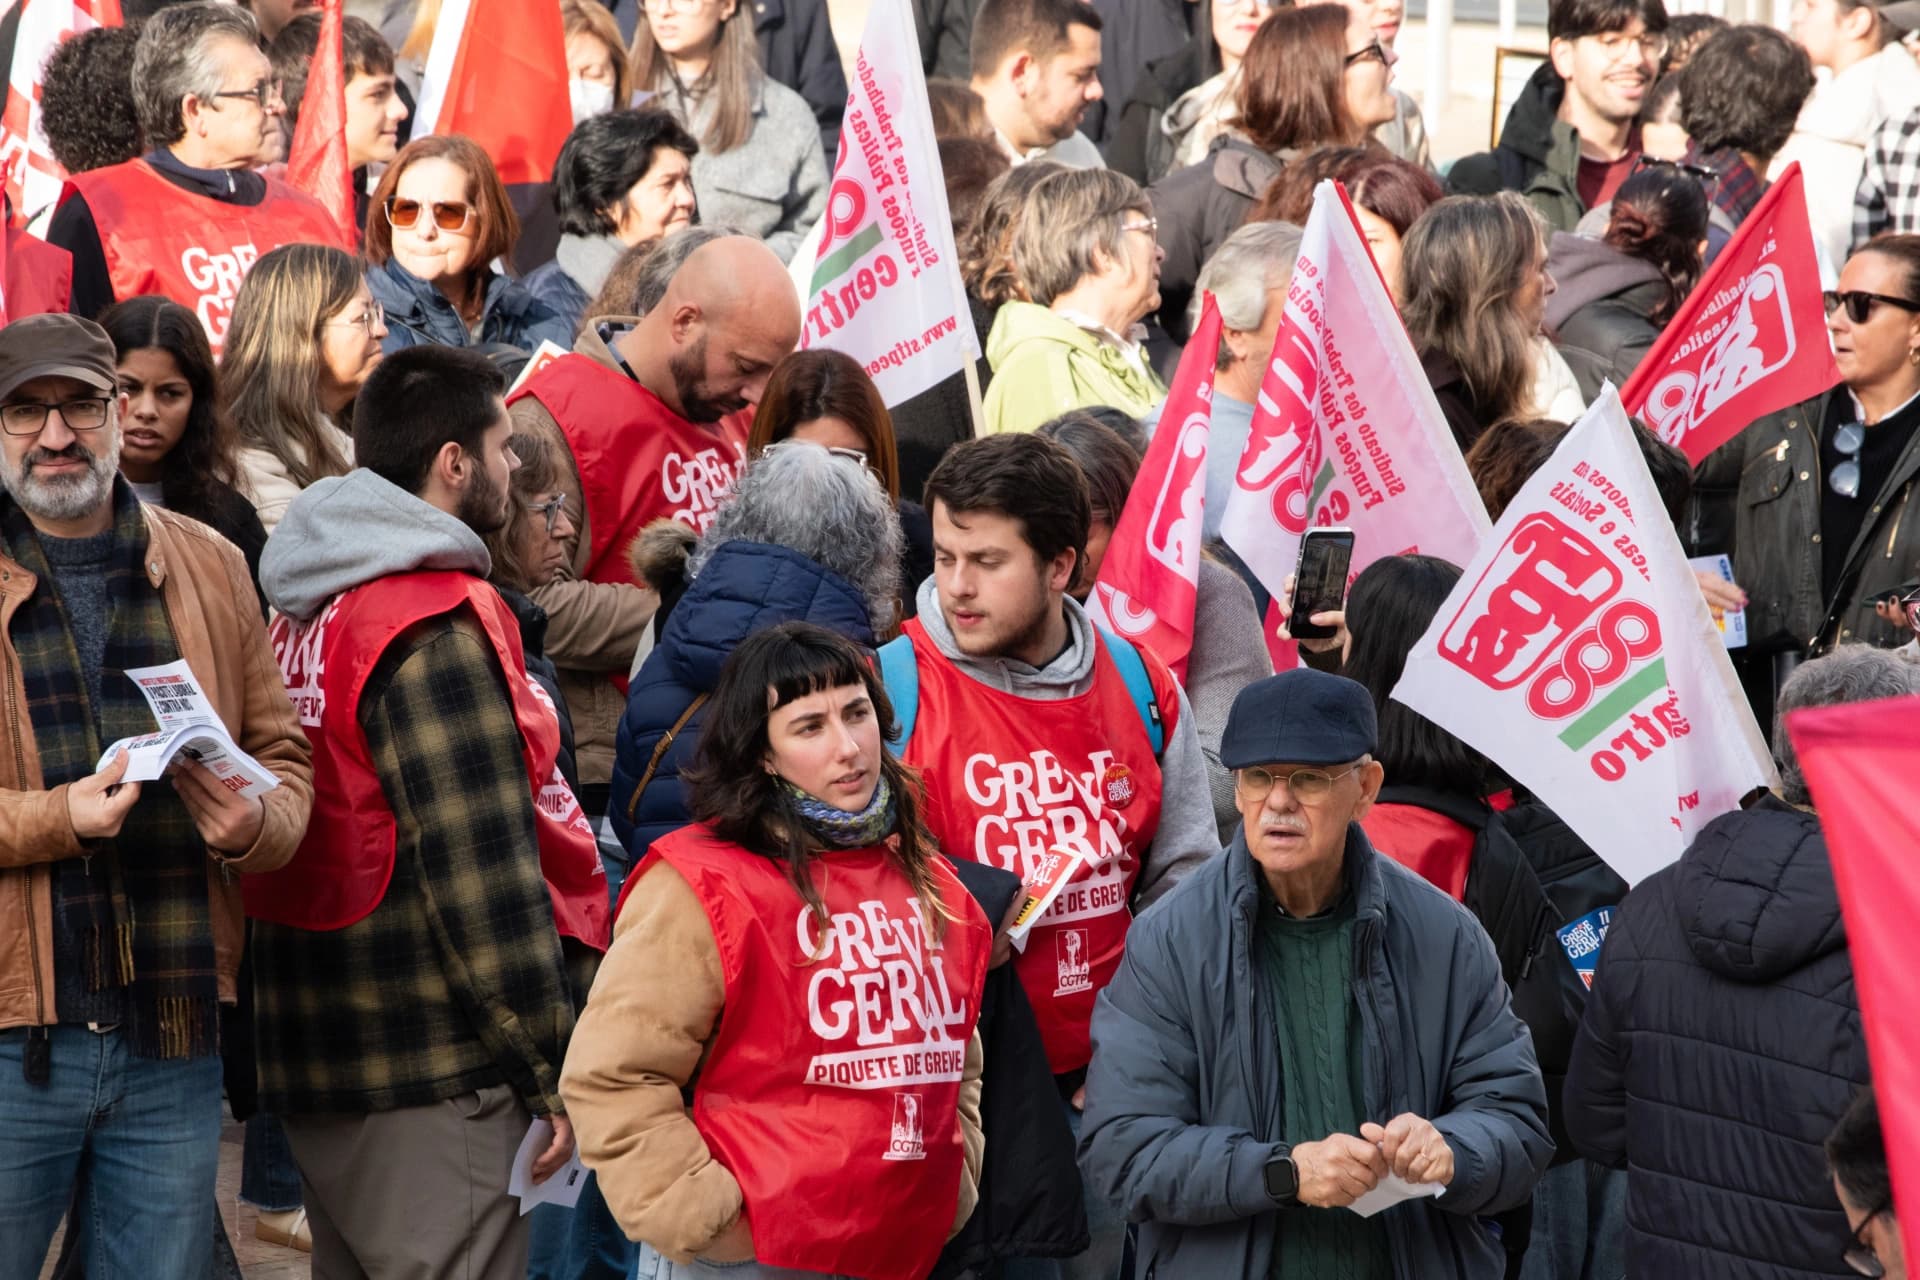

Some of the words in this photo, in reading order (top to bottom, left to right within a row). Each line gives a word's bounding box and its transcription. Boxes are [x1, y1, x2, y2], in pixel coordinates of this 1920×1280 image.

[182, 243, 260, 298] GRE
[662, 441, 748, 512] GREV
[975, 806, 1130, 887] GERA
[1068, 890, 1087, 913] DE
[1599, 910, 1610, 925] 11
[1561, 920, 1593, 946] GREVE
[1568, 931, 1600, 959] GERAL
[1060, 973, 1088, 988] CGTP
[808, 956, 966, 1047] GERAL
[814, 1057, 901, 1085] PIQUETE
[904, 1053, 921, 1076] DE
[925, 1050, 963, 1074] GREVE
[892, 1140, 922, 1153] CGTP
